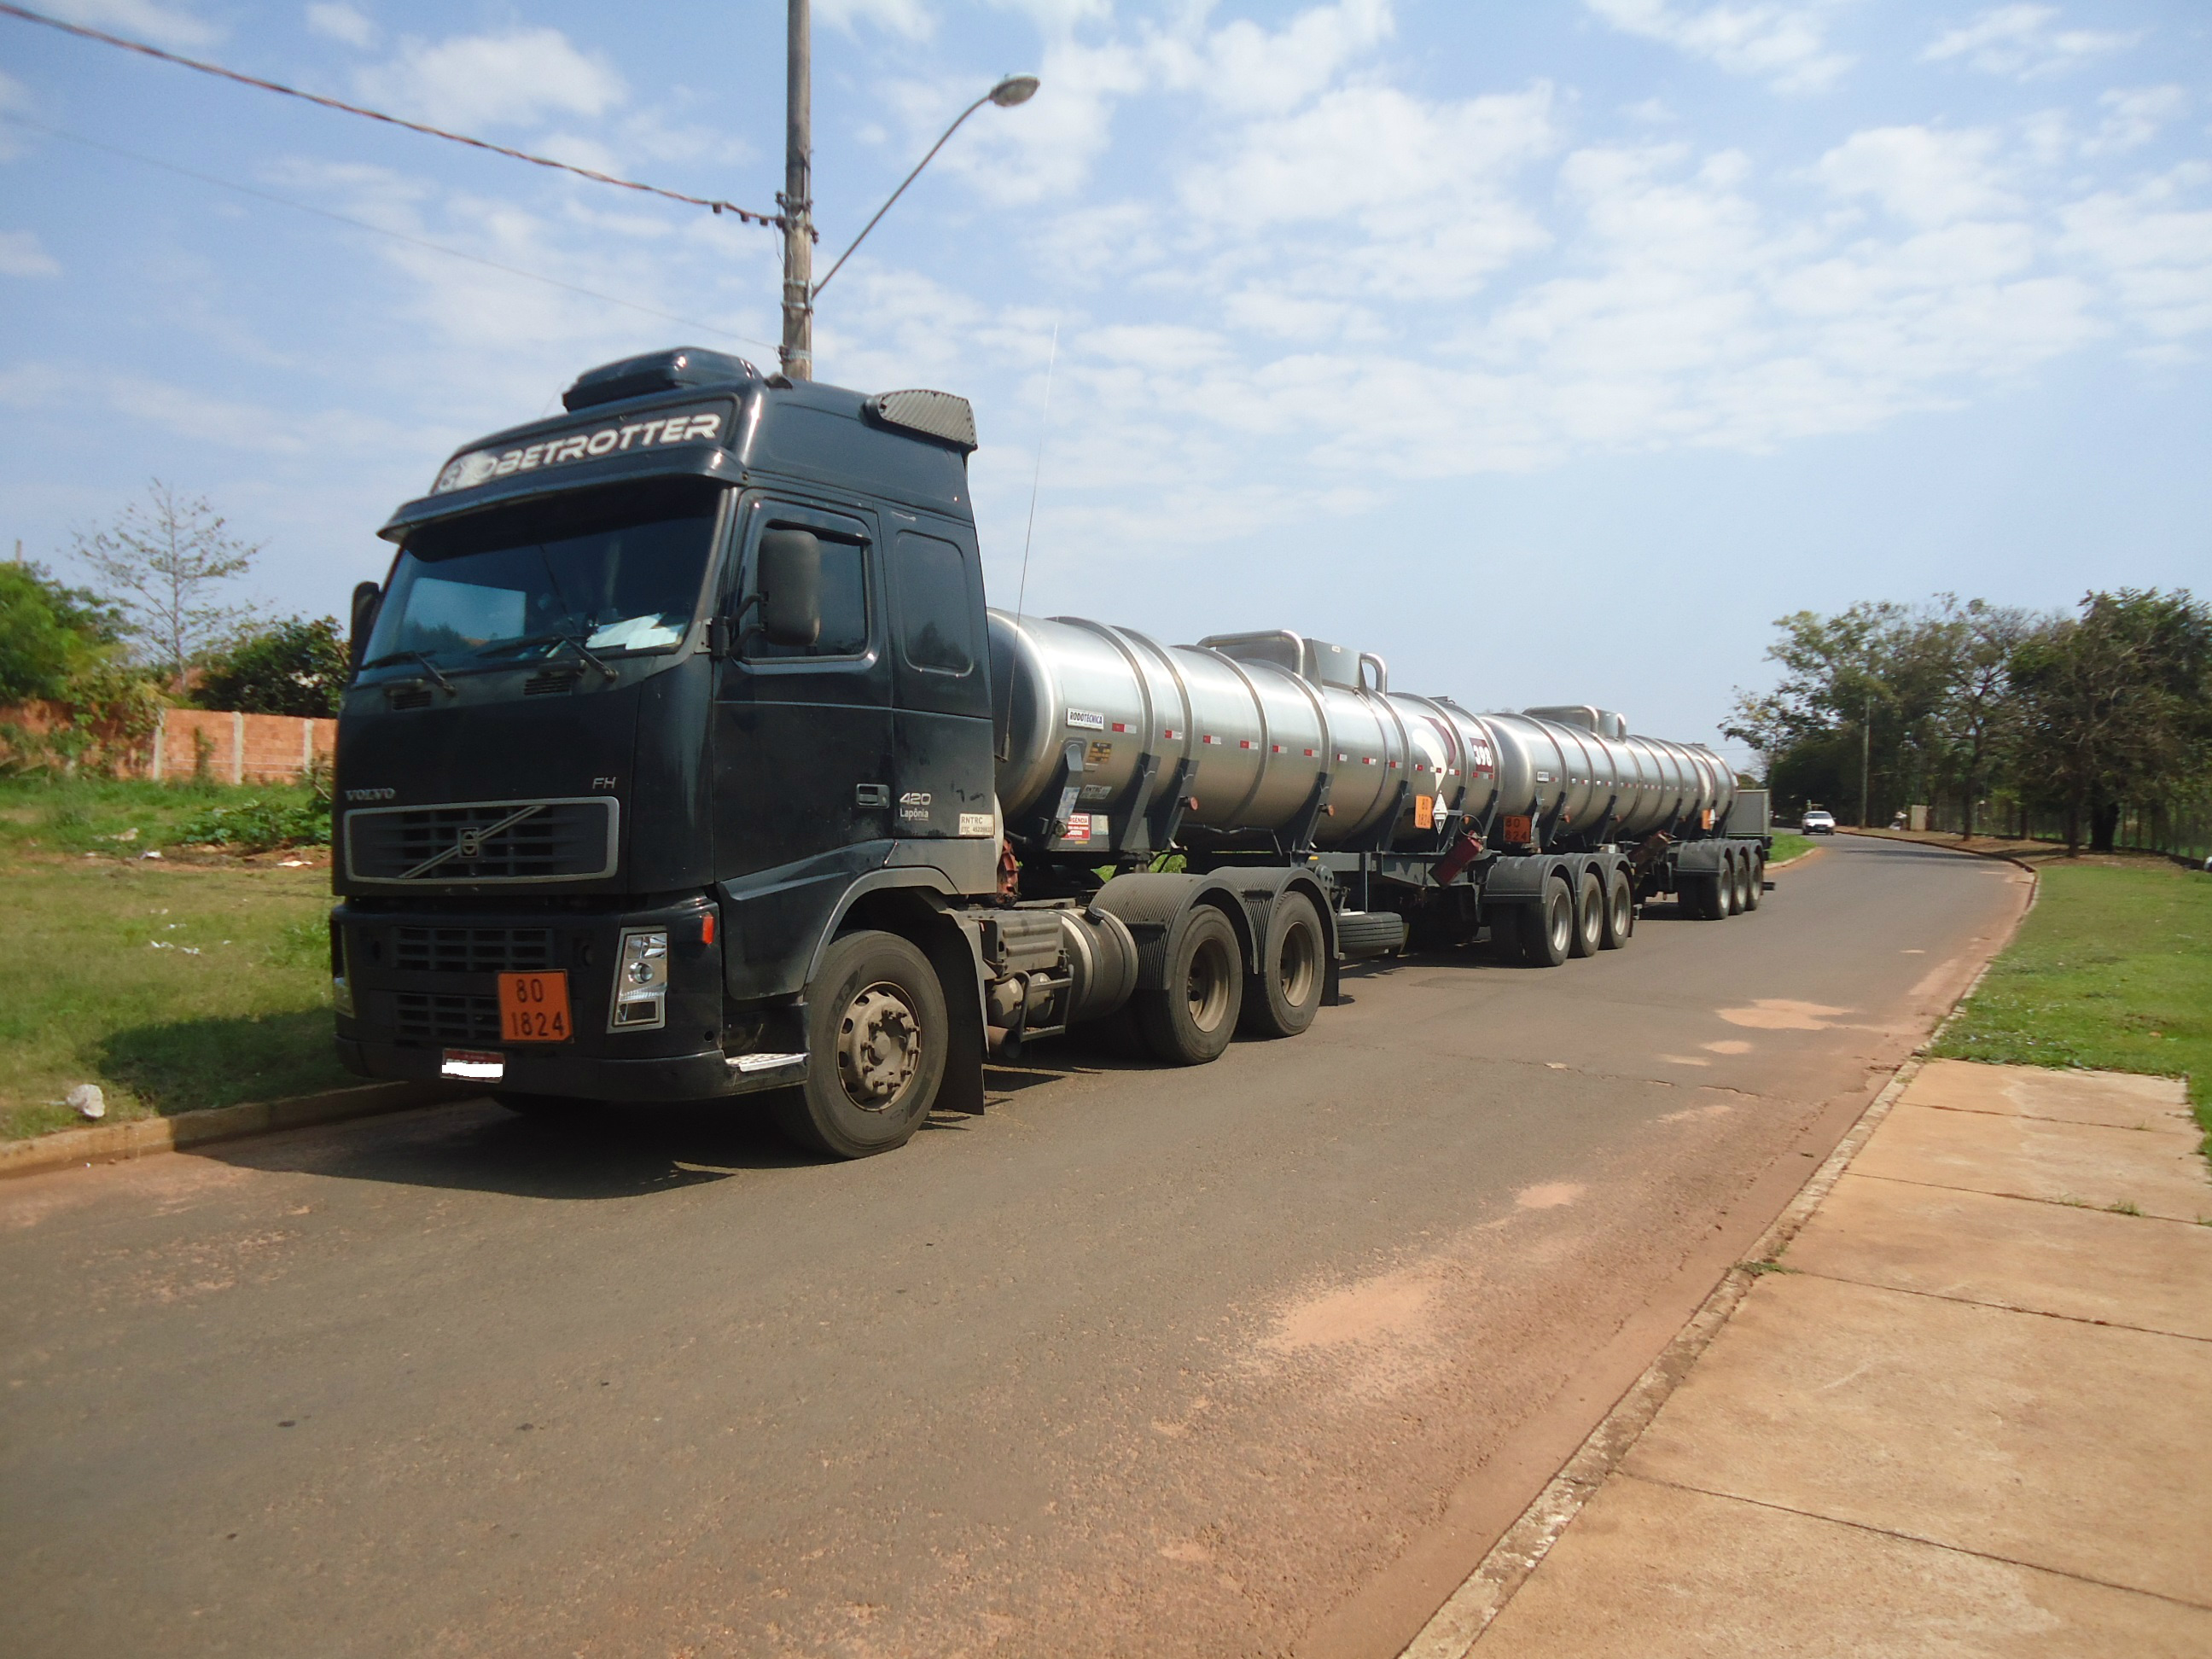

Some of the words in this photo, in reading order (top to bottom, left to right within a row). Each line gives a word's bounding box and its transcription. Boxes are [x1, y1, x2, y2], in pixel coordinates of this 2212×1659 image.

[1473, 744, 1493, 767] 398
[592, 777, 616, 789] FH
[345, 787, 397, 801] VOLVO
[899, 792, 932, 806] 420
[899, 807, 929, 821] Lapônia
[961, 816, 983, 824] RNTRC
[1505, 818, 1520, 828] 80
[515, 978, 544, 1003] 80
[511, 1011, 565, 1037] 1824
